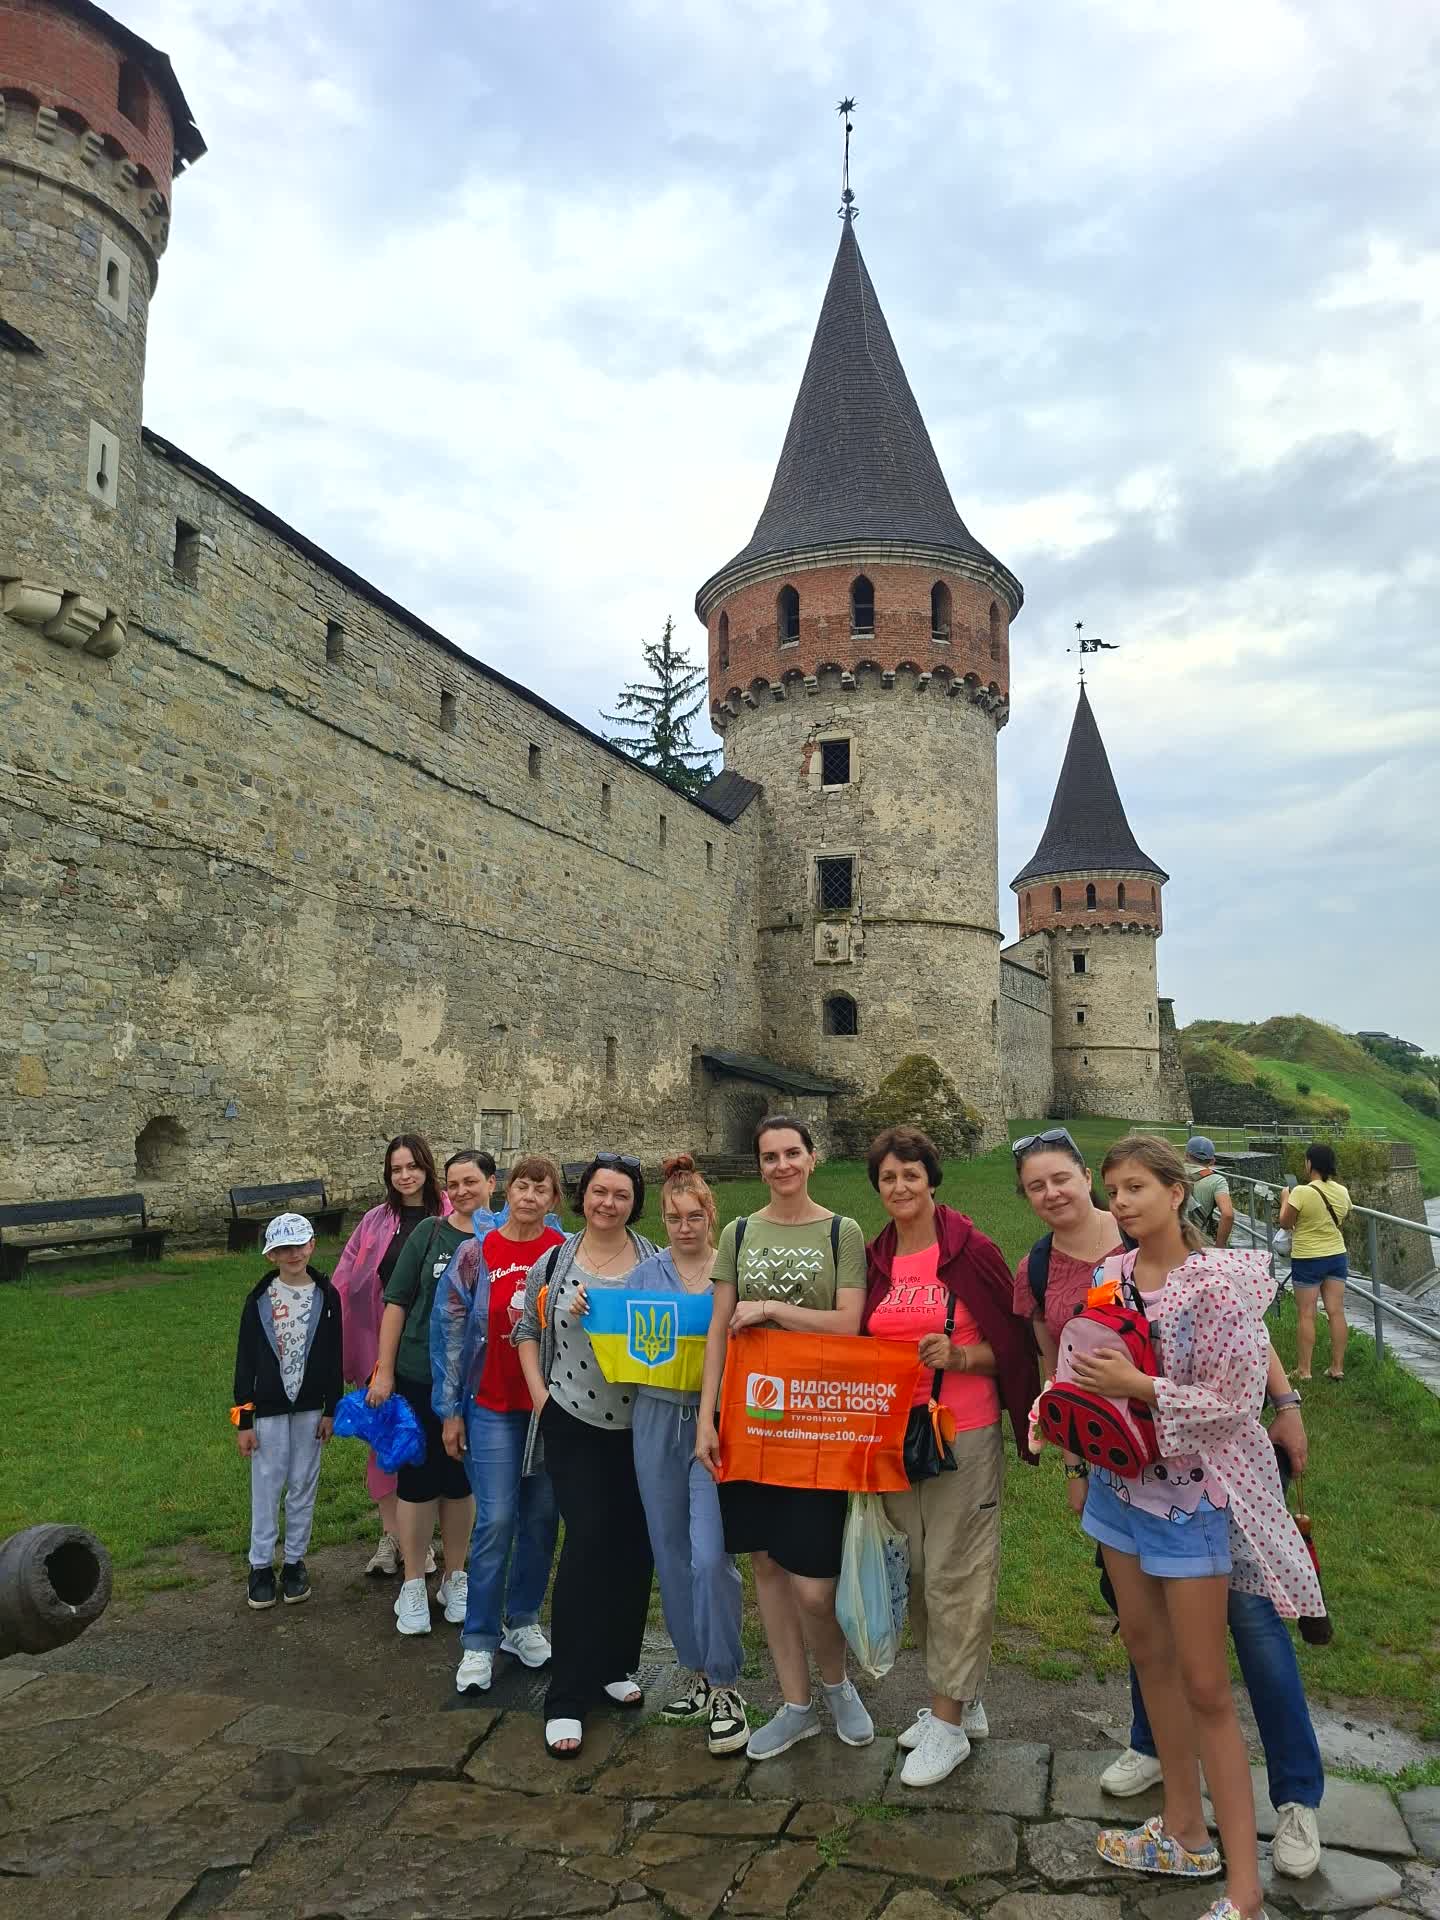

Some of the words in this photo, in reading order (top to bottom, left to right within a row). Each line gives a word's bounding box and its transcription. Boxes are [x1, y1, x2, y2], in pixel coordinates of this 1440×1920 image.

[489, 1262, 533, 1283] Hackney
[790, 1379, 897, 1398] ВІДПОЧИНОК
[790, 1394, 814, 1409] НА
[817, 1395, 841, 1409] ВСІ
[845, 1396, 890, 1412] 100%
[791, 1414, 848, 1423] ТУРОПЕРАТОР
